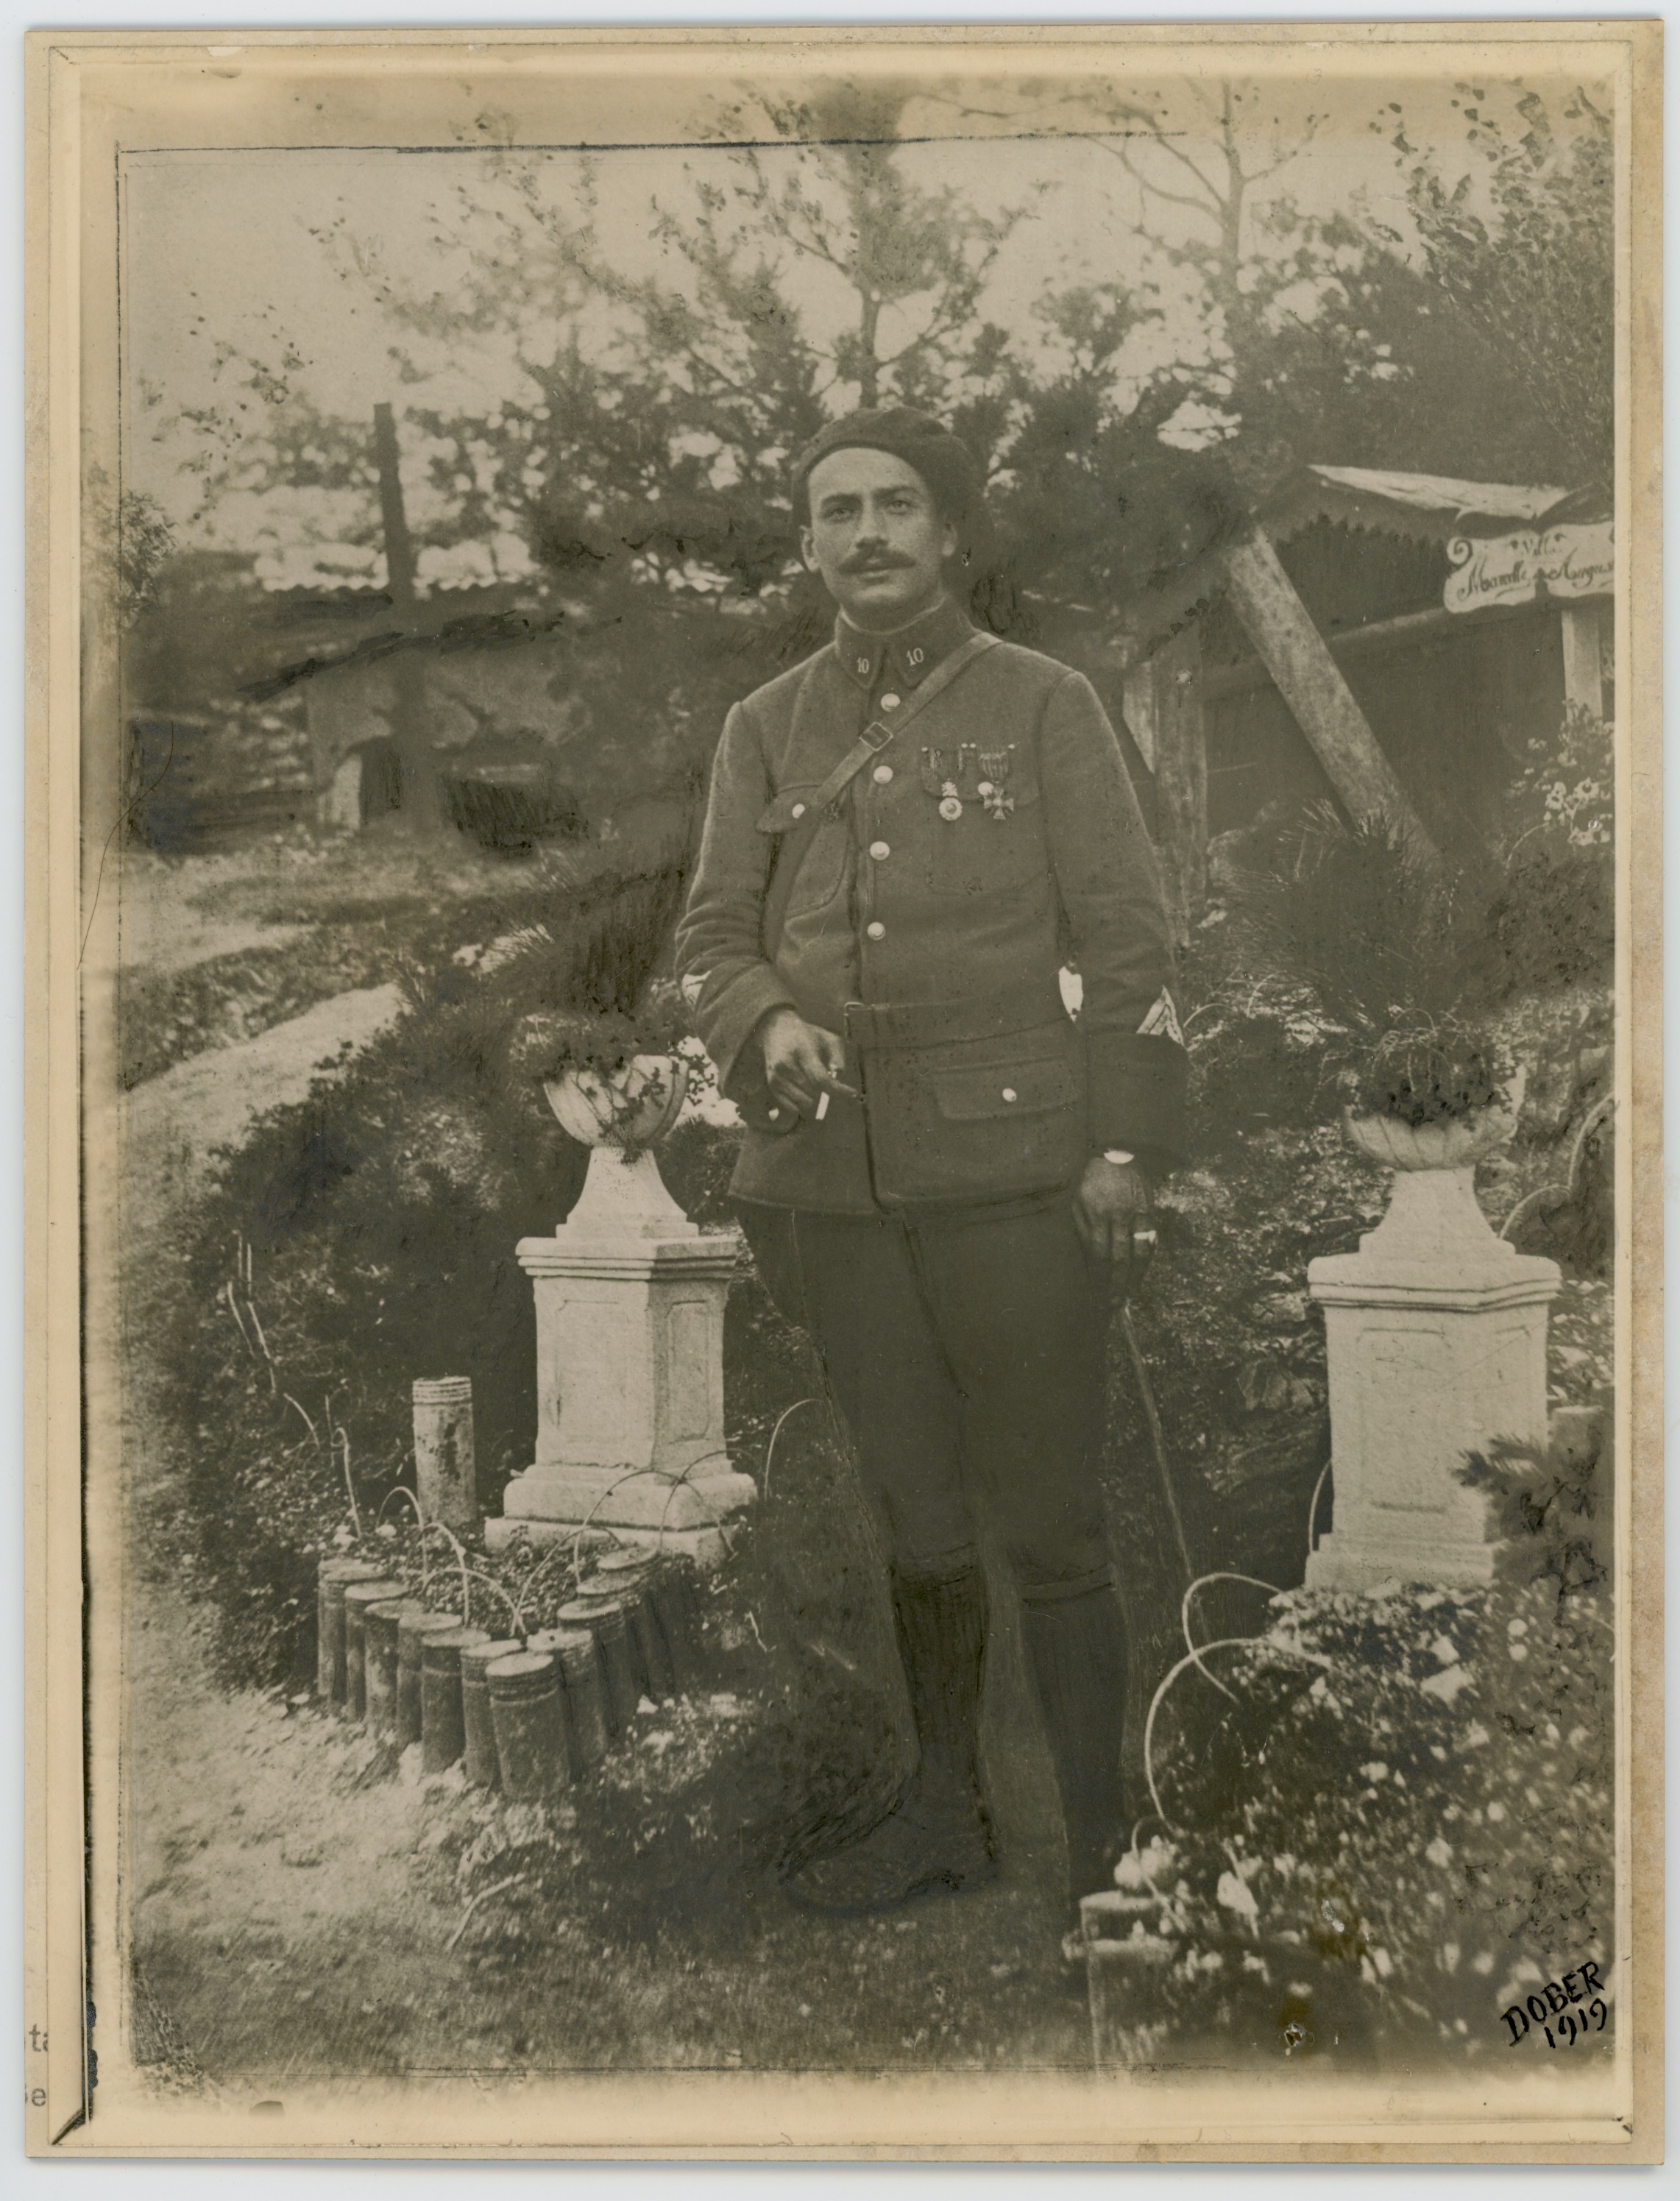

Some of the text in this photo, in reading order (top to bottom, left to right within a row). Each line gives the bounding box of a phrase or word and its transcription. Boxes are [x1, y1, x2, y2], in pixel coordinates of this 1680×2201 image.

[857, 657, 870, 674] 10
[906, 648, 924, 666] 10
[1500, 1961, 1606, 2047] DOBER
[1544, 1997, 1607, 2049] 1919
